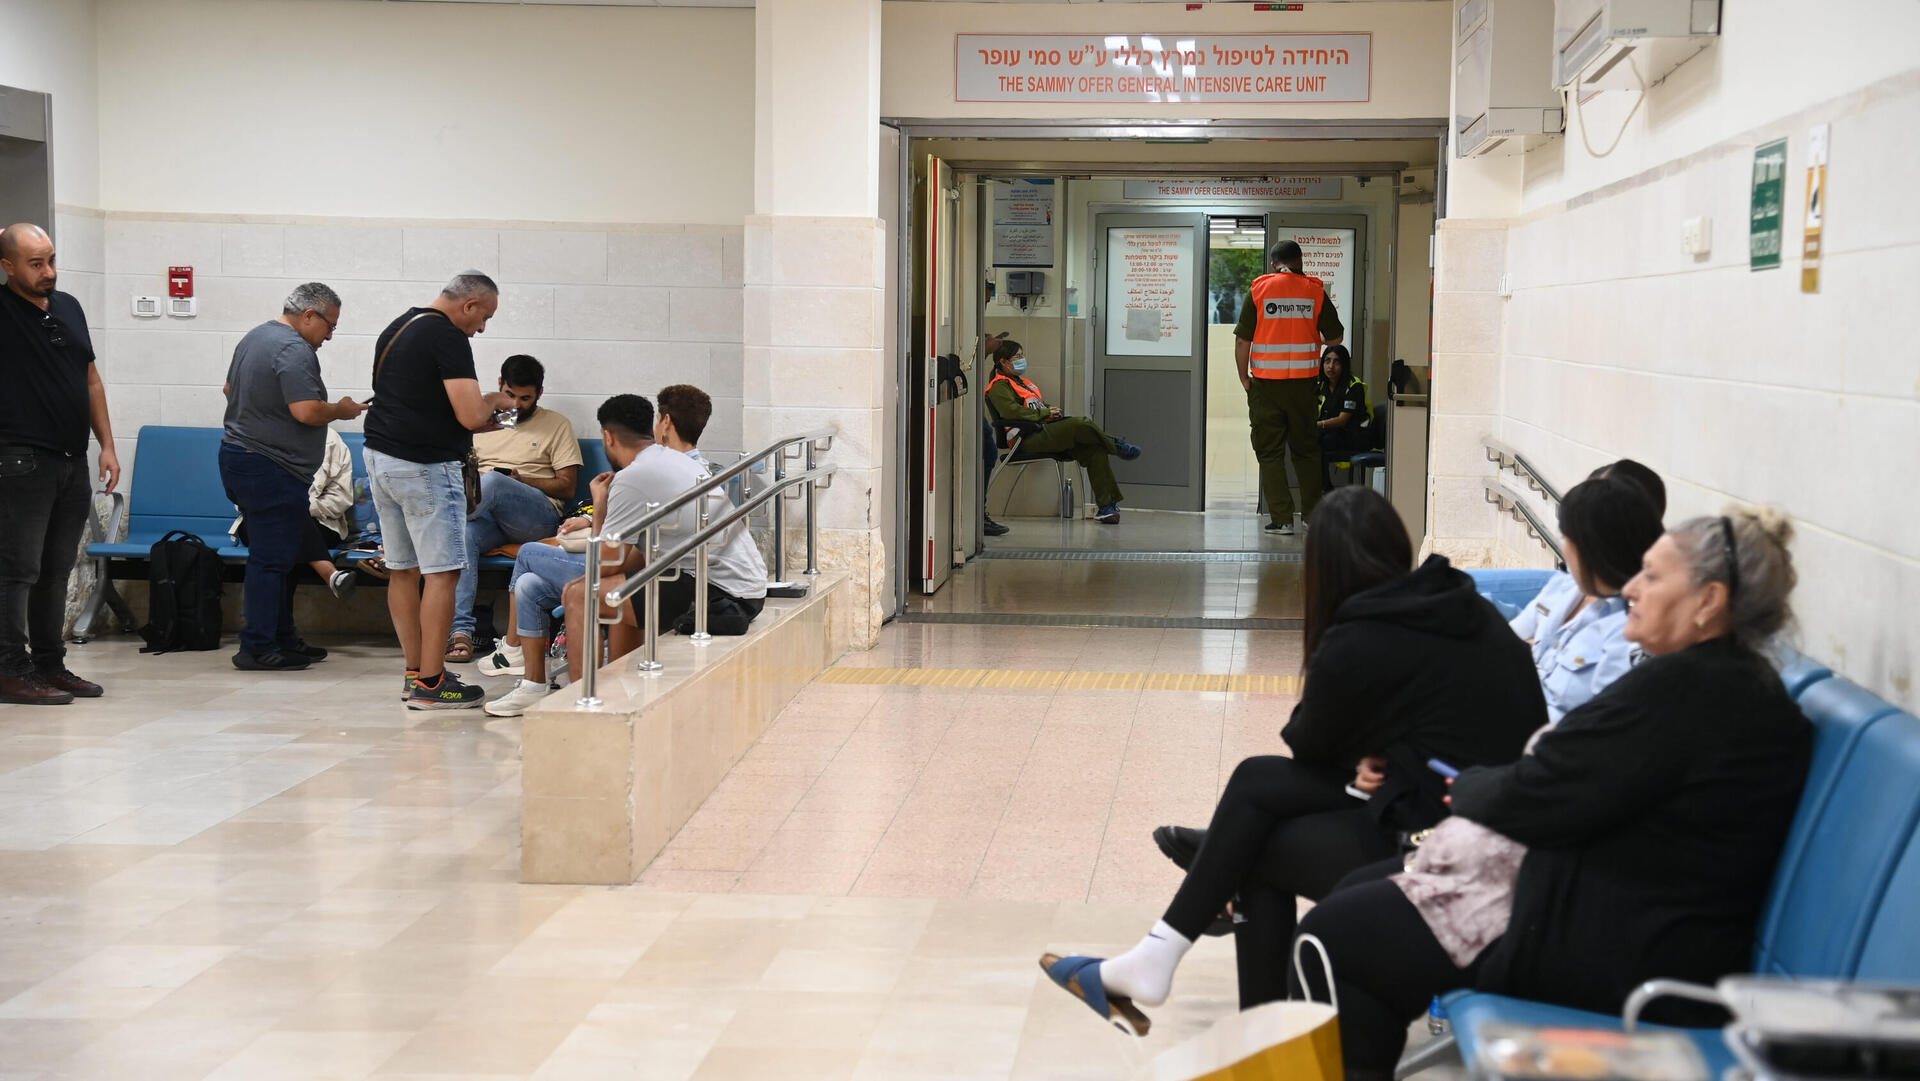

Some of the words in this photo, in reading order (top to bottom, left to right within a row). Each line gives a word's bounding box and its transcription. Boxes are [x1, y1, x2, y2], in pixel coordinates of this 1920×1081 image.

[978, 49, 1021, 67] עופר
[1028, 49, 1062, 66] סמי
[1114, 45, 1153, 66] כללי
[1160, 49, 1206, 71] נמרץ
[1212, 44, 1275, 66] לטיפול
[1282, 48, 1349, 66] היחידה
[998, 76, 1024, 93] THE
[1027, 76, 1075, 93] SAMMY
[1078, 76, 1114, 93] OFER
[1117, 76, 1180, 93] GENERAL
[1183, 76, 1251, 93] INTENSIVE
[1255, 76, 1293, 93] CARE
[1296, 76, 1327, 93] UNIT
[1158, 186, 1170, 195] THE
[1171, 186, 1194, 195] SAMMY
[1194, 186, 1211, 196] OFER
[1211, 186, 1241, 196] GENERAL
[1241, 187, 1273, 196] INTENSIVE
[1274, 187, 1292, 196] CARE
[1292, 187, 1308, 196] UNIT
[440, 691, 462, 699] HOKA
